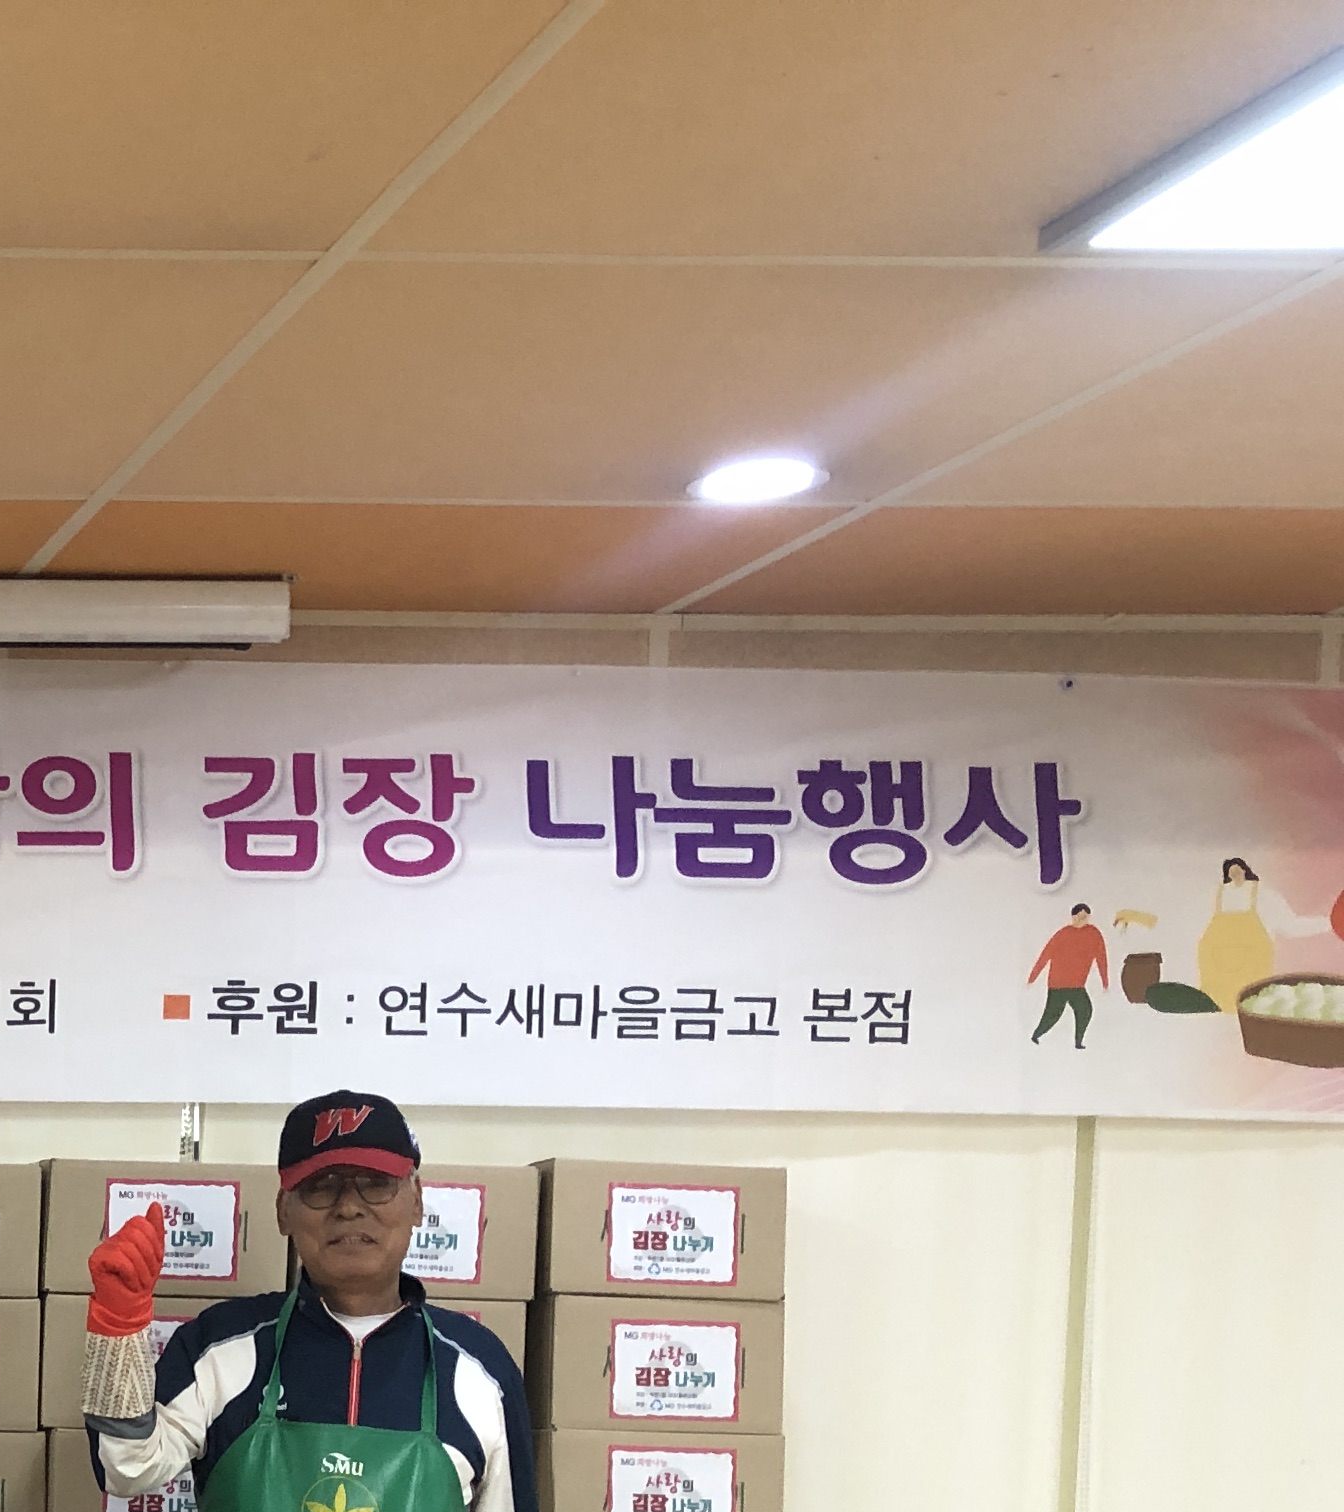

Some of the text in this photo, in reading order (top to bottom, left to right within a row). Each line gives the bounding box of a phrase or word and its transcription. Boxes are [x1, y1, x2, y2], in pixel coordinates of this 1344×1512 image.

[202, 753, 475, 877] 김장
[527, 757, 1081, 884] 나눔행사
[207, 980, 318, 1035] 후원
[379, 982, 780, 1041] 연수새마을금고
[803, 988, 912, 1045] 본점
[313, 1105, 374, 1146] W
[118, 1190, 134, 1199] MG
[646, 1210, 695, 1231] 사랑의
[171, 1230, 214, 1248] 나누기
[416, 1232, 458, 1250] 나누기
[632, 1230, 713, 1252] 김장 나누기
[649, 1346, 696, 1368] 사랑의
[635, 1367, 715, 1388] 김장 나누기
[321, 1453, 363, 1476] SMU
[646, 1473, 693, 1494] 사랑의
